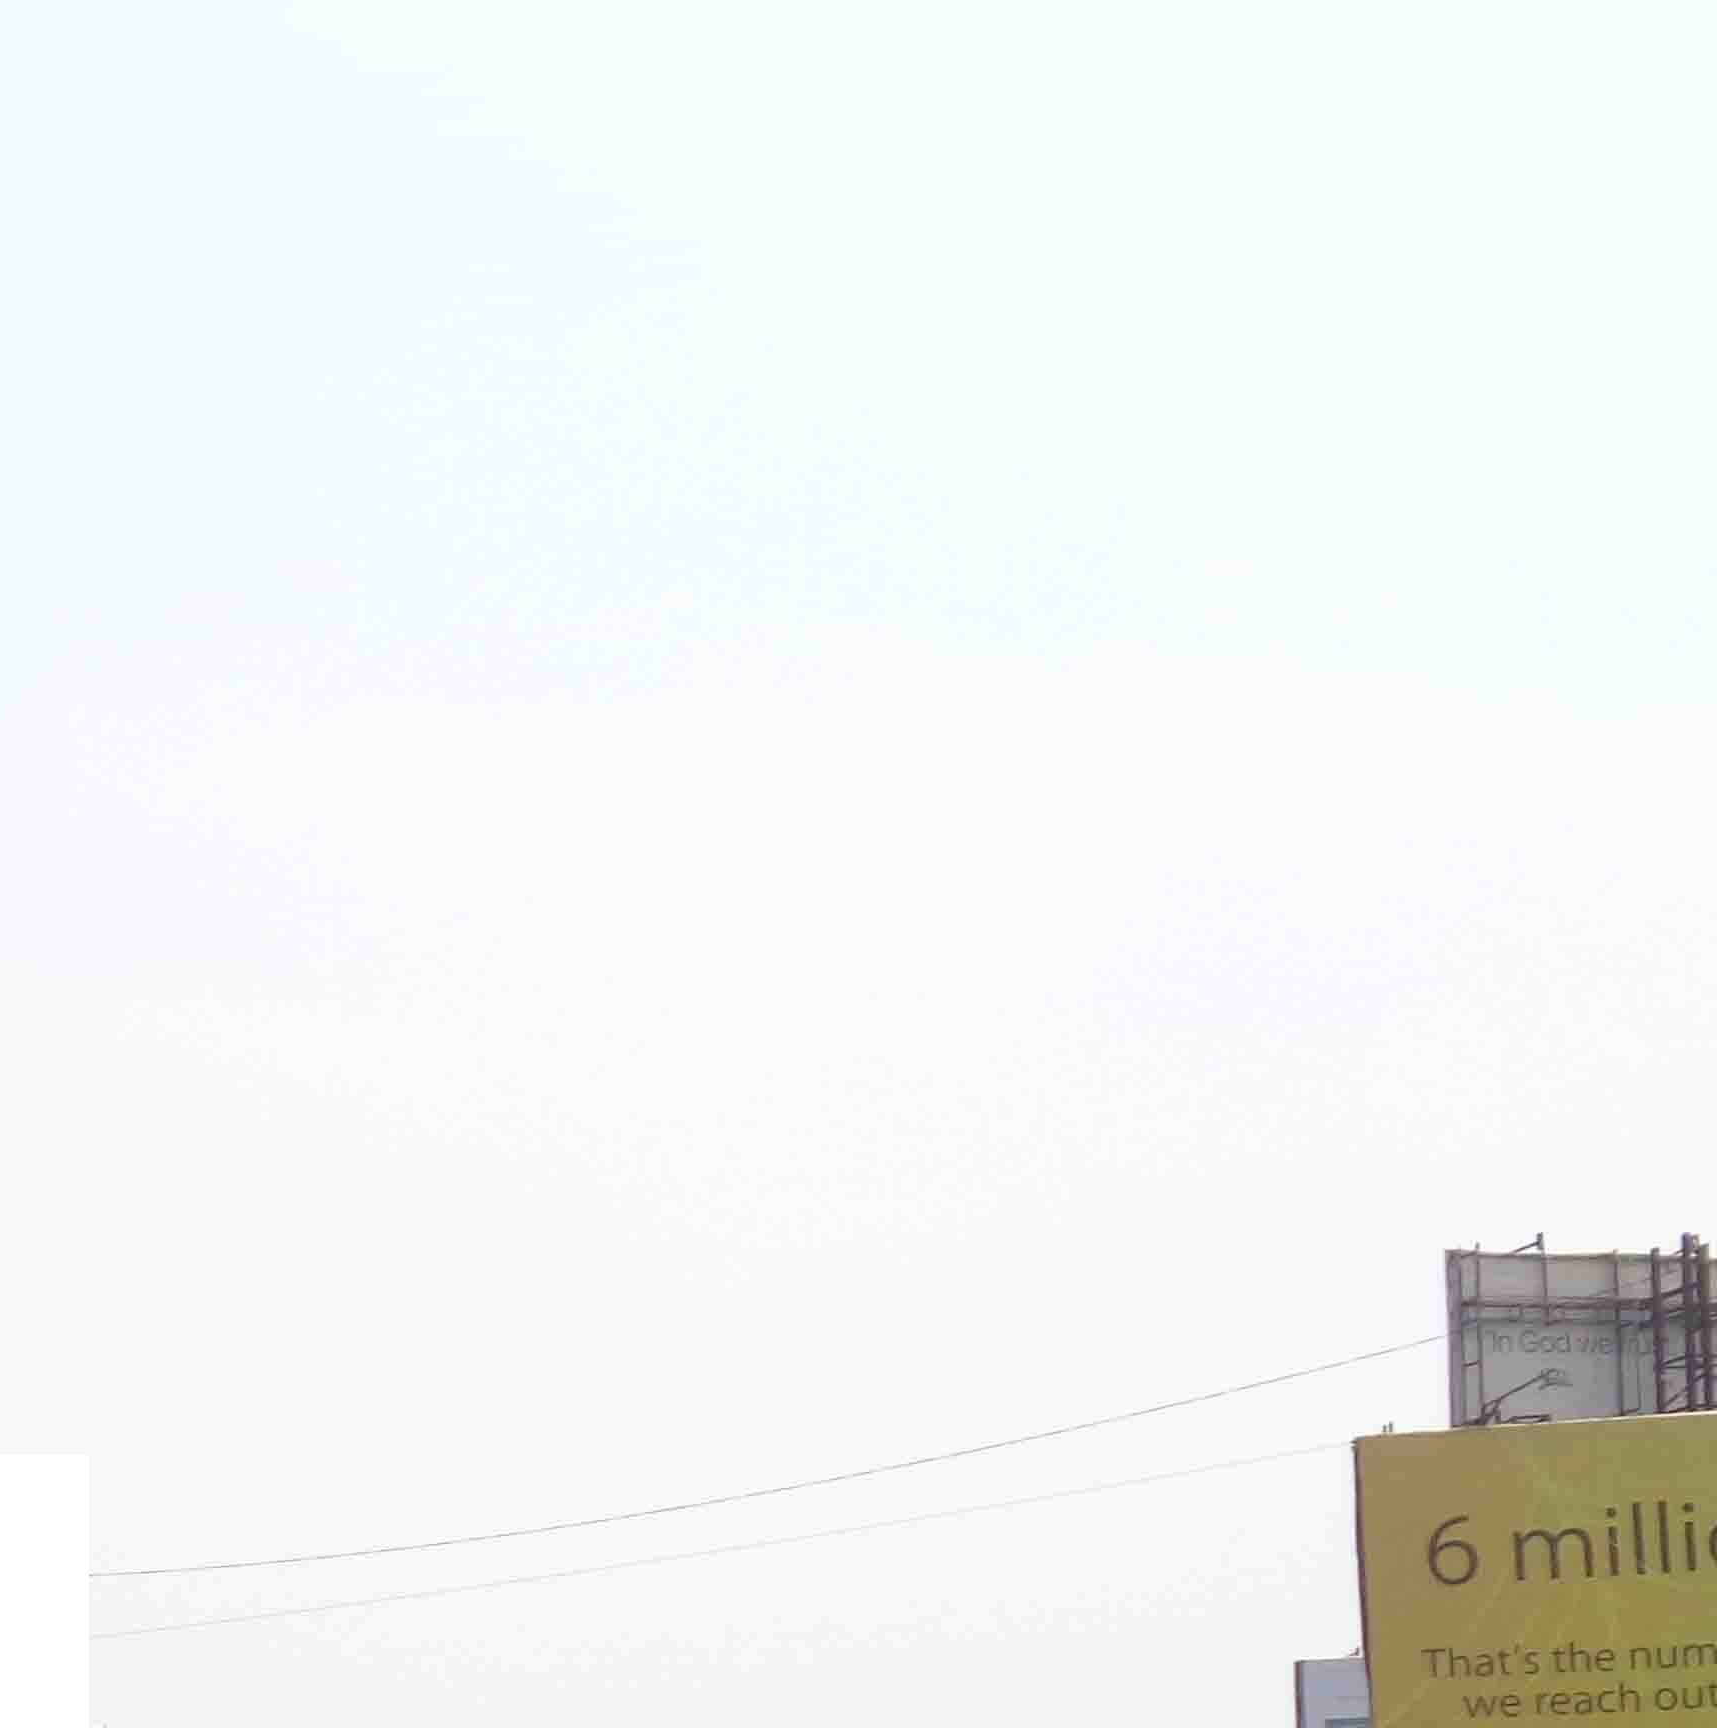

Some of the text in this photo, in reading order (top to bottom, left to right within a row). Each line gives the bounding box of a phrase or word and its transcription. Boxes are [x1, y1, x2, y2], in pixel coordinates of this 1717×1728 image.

[1427, 1500, 1717, 1585] 6 milli
[1421, 1643, 1540, 1681] That's
[1552, 1640, 1616, 1676] the
[1463, 1690, 1521, 1719] we
[1535, 1682, 1640, 1716] reach
